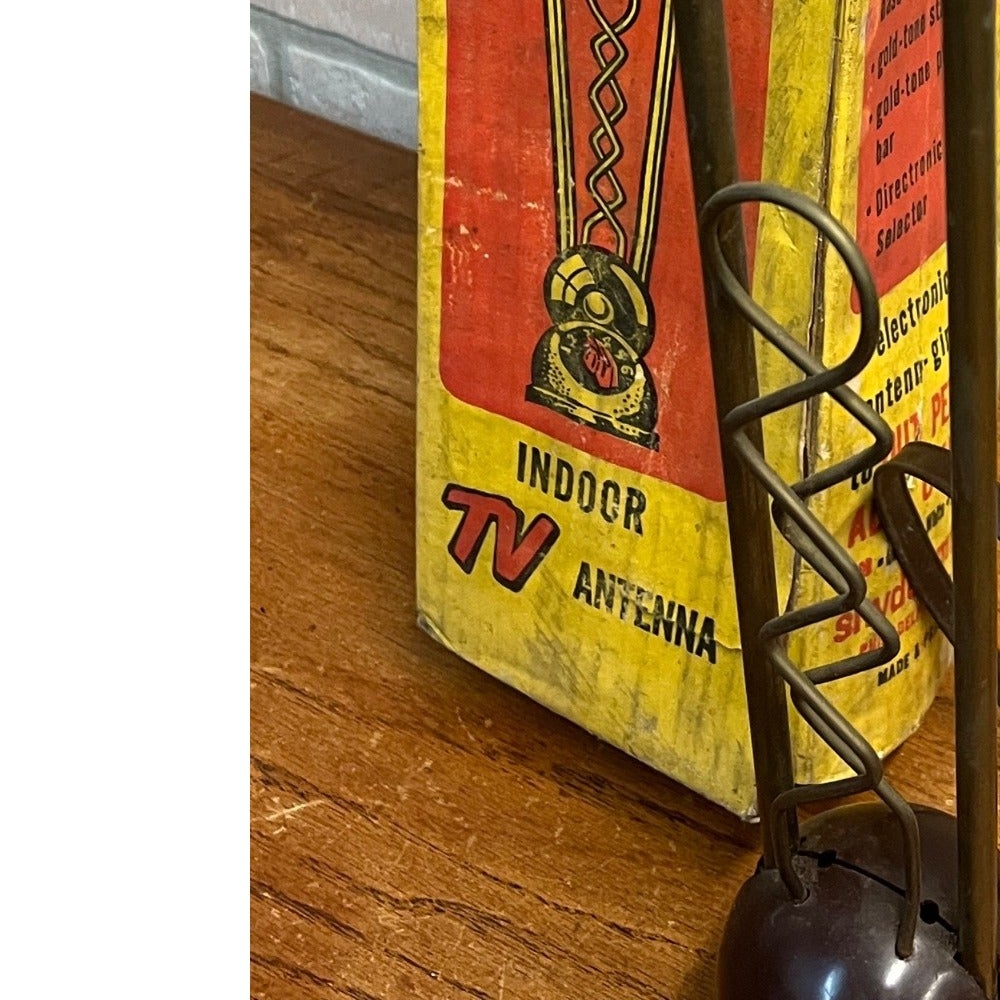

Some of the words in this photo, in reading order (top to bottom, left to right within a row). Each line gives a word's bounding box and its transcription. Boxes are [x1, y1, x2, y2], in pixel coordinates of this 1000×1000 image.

[876, 60, 930, 130] gold-tone
[875, 139, 943, 218] Directronic
[876, 131, 895, 166] bar
[876, 193, 928, 257] Selector
[516, 440, 647, 537] INDOOR
[441, 482, 561, 594] TV
[572, 560, 718, 665] ANTENNA
[877, 653, 911, 688] MADE
